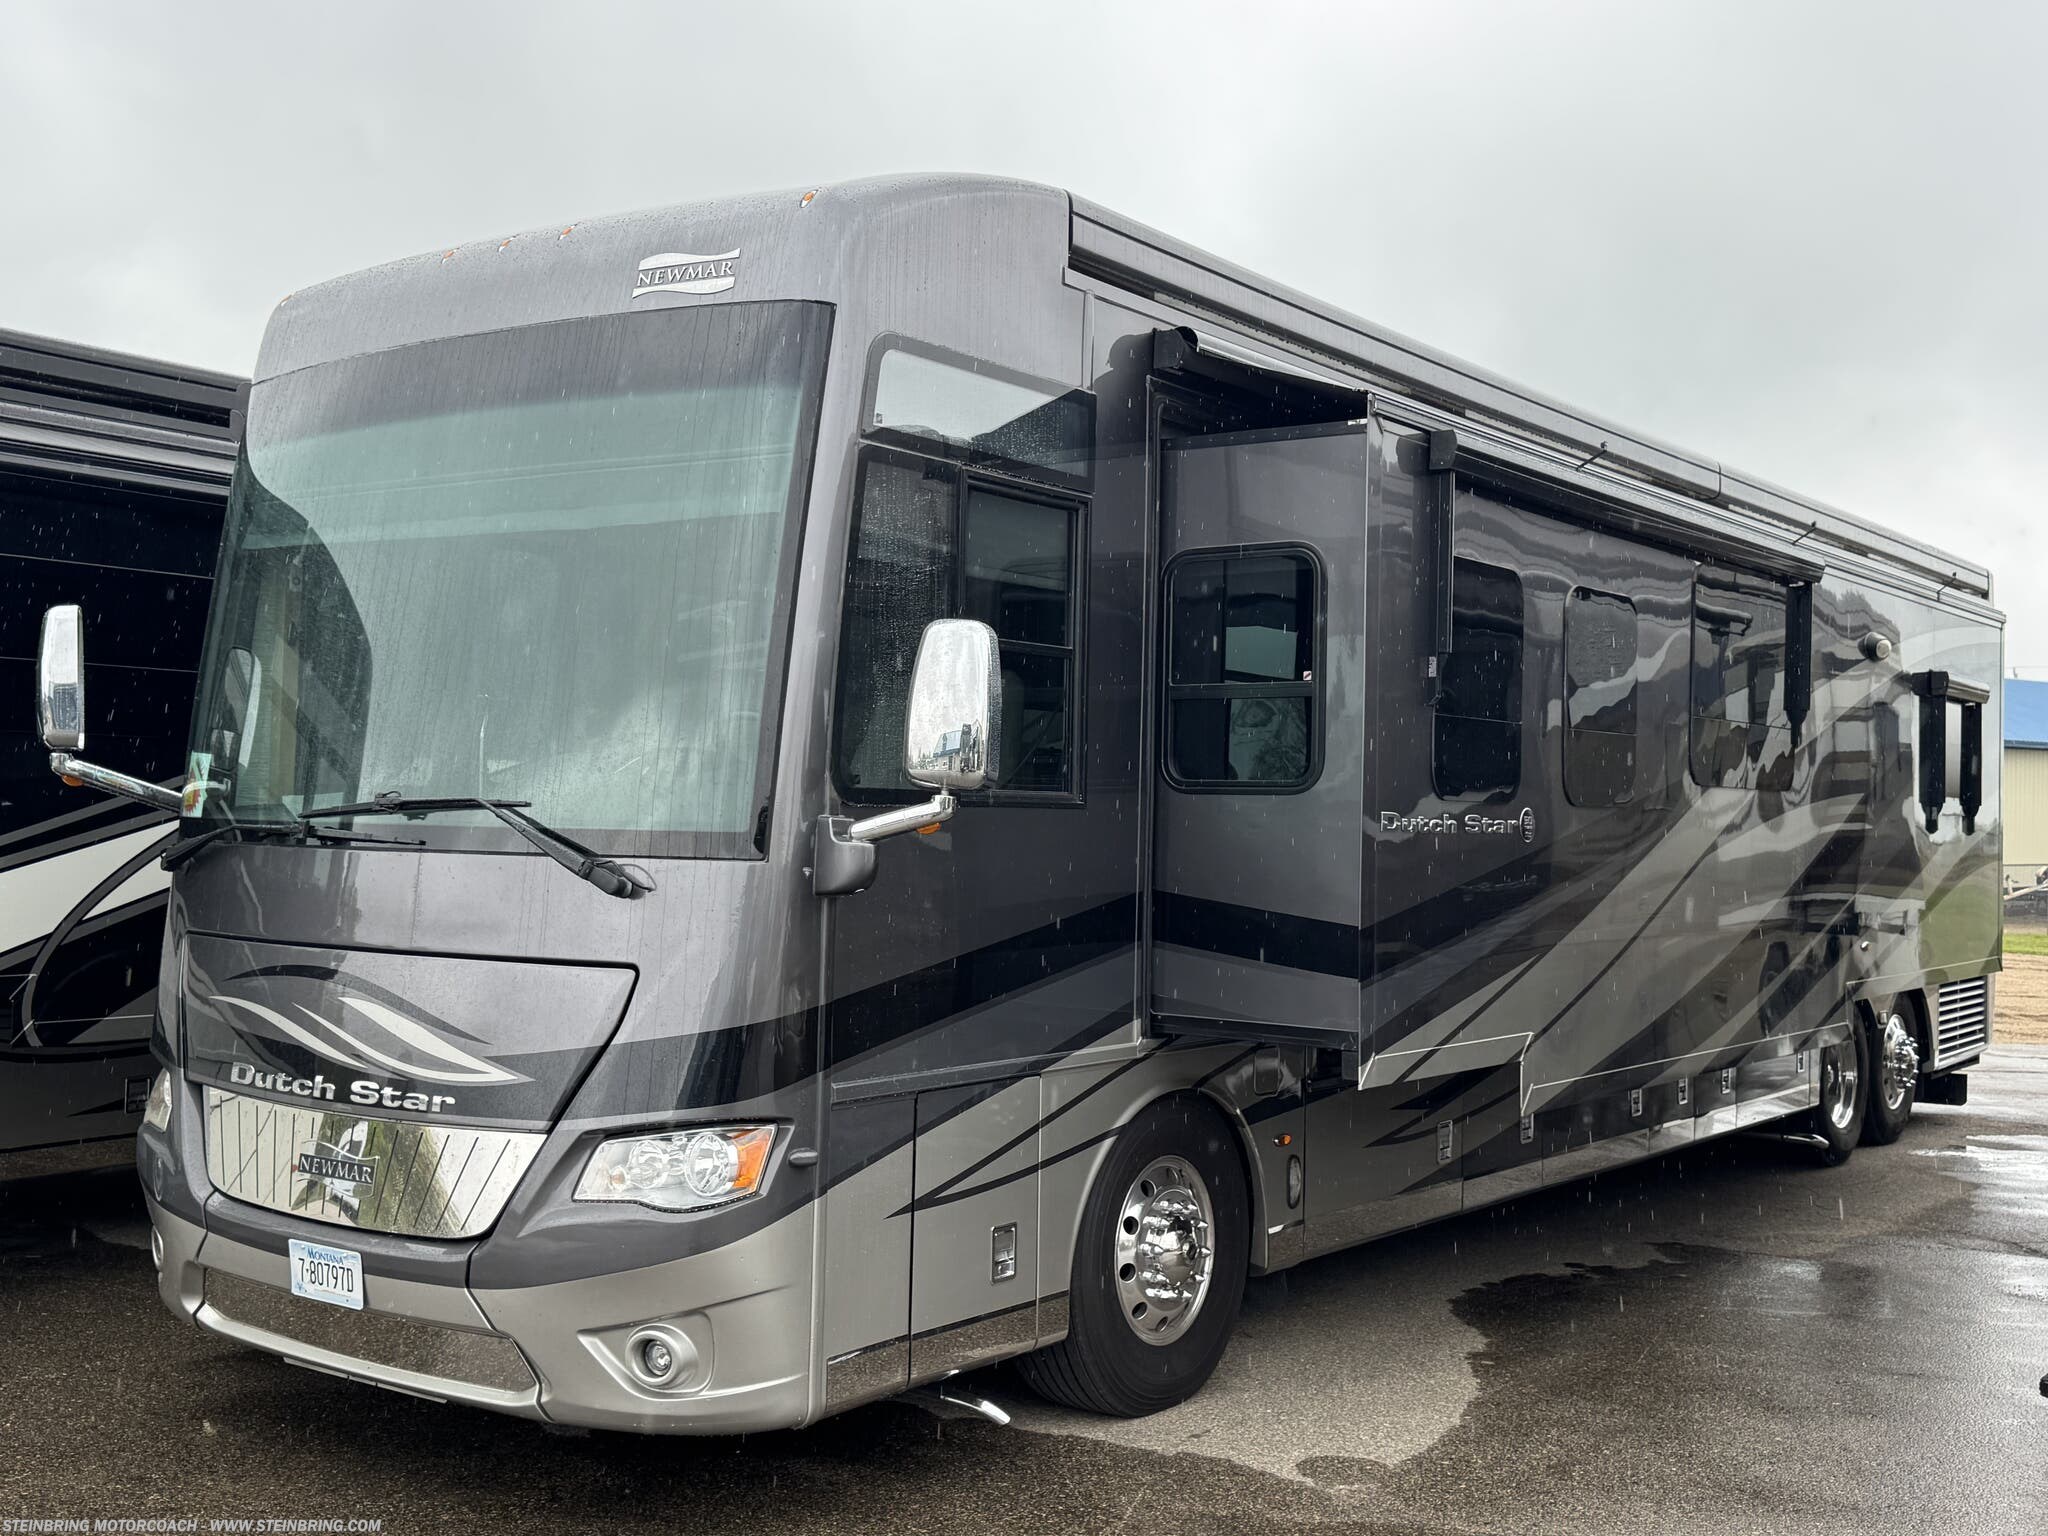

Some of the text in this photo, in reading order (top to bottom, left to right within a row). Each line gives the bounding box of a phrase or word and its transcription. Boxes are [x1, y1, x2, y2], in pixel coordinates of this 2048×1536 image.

[636, 260, 734, 287] NEWMAR
[1380, 811, 1457, 834] Dutch
[1464, 814, 1519, 834] Star
[230, 1061, 456, 1113] Dutch Star
[300, 1156, 373, 1184] NEWMAR
[307, 1247, 344, 1265] MONTANA
